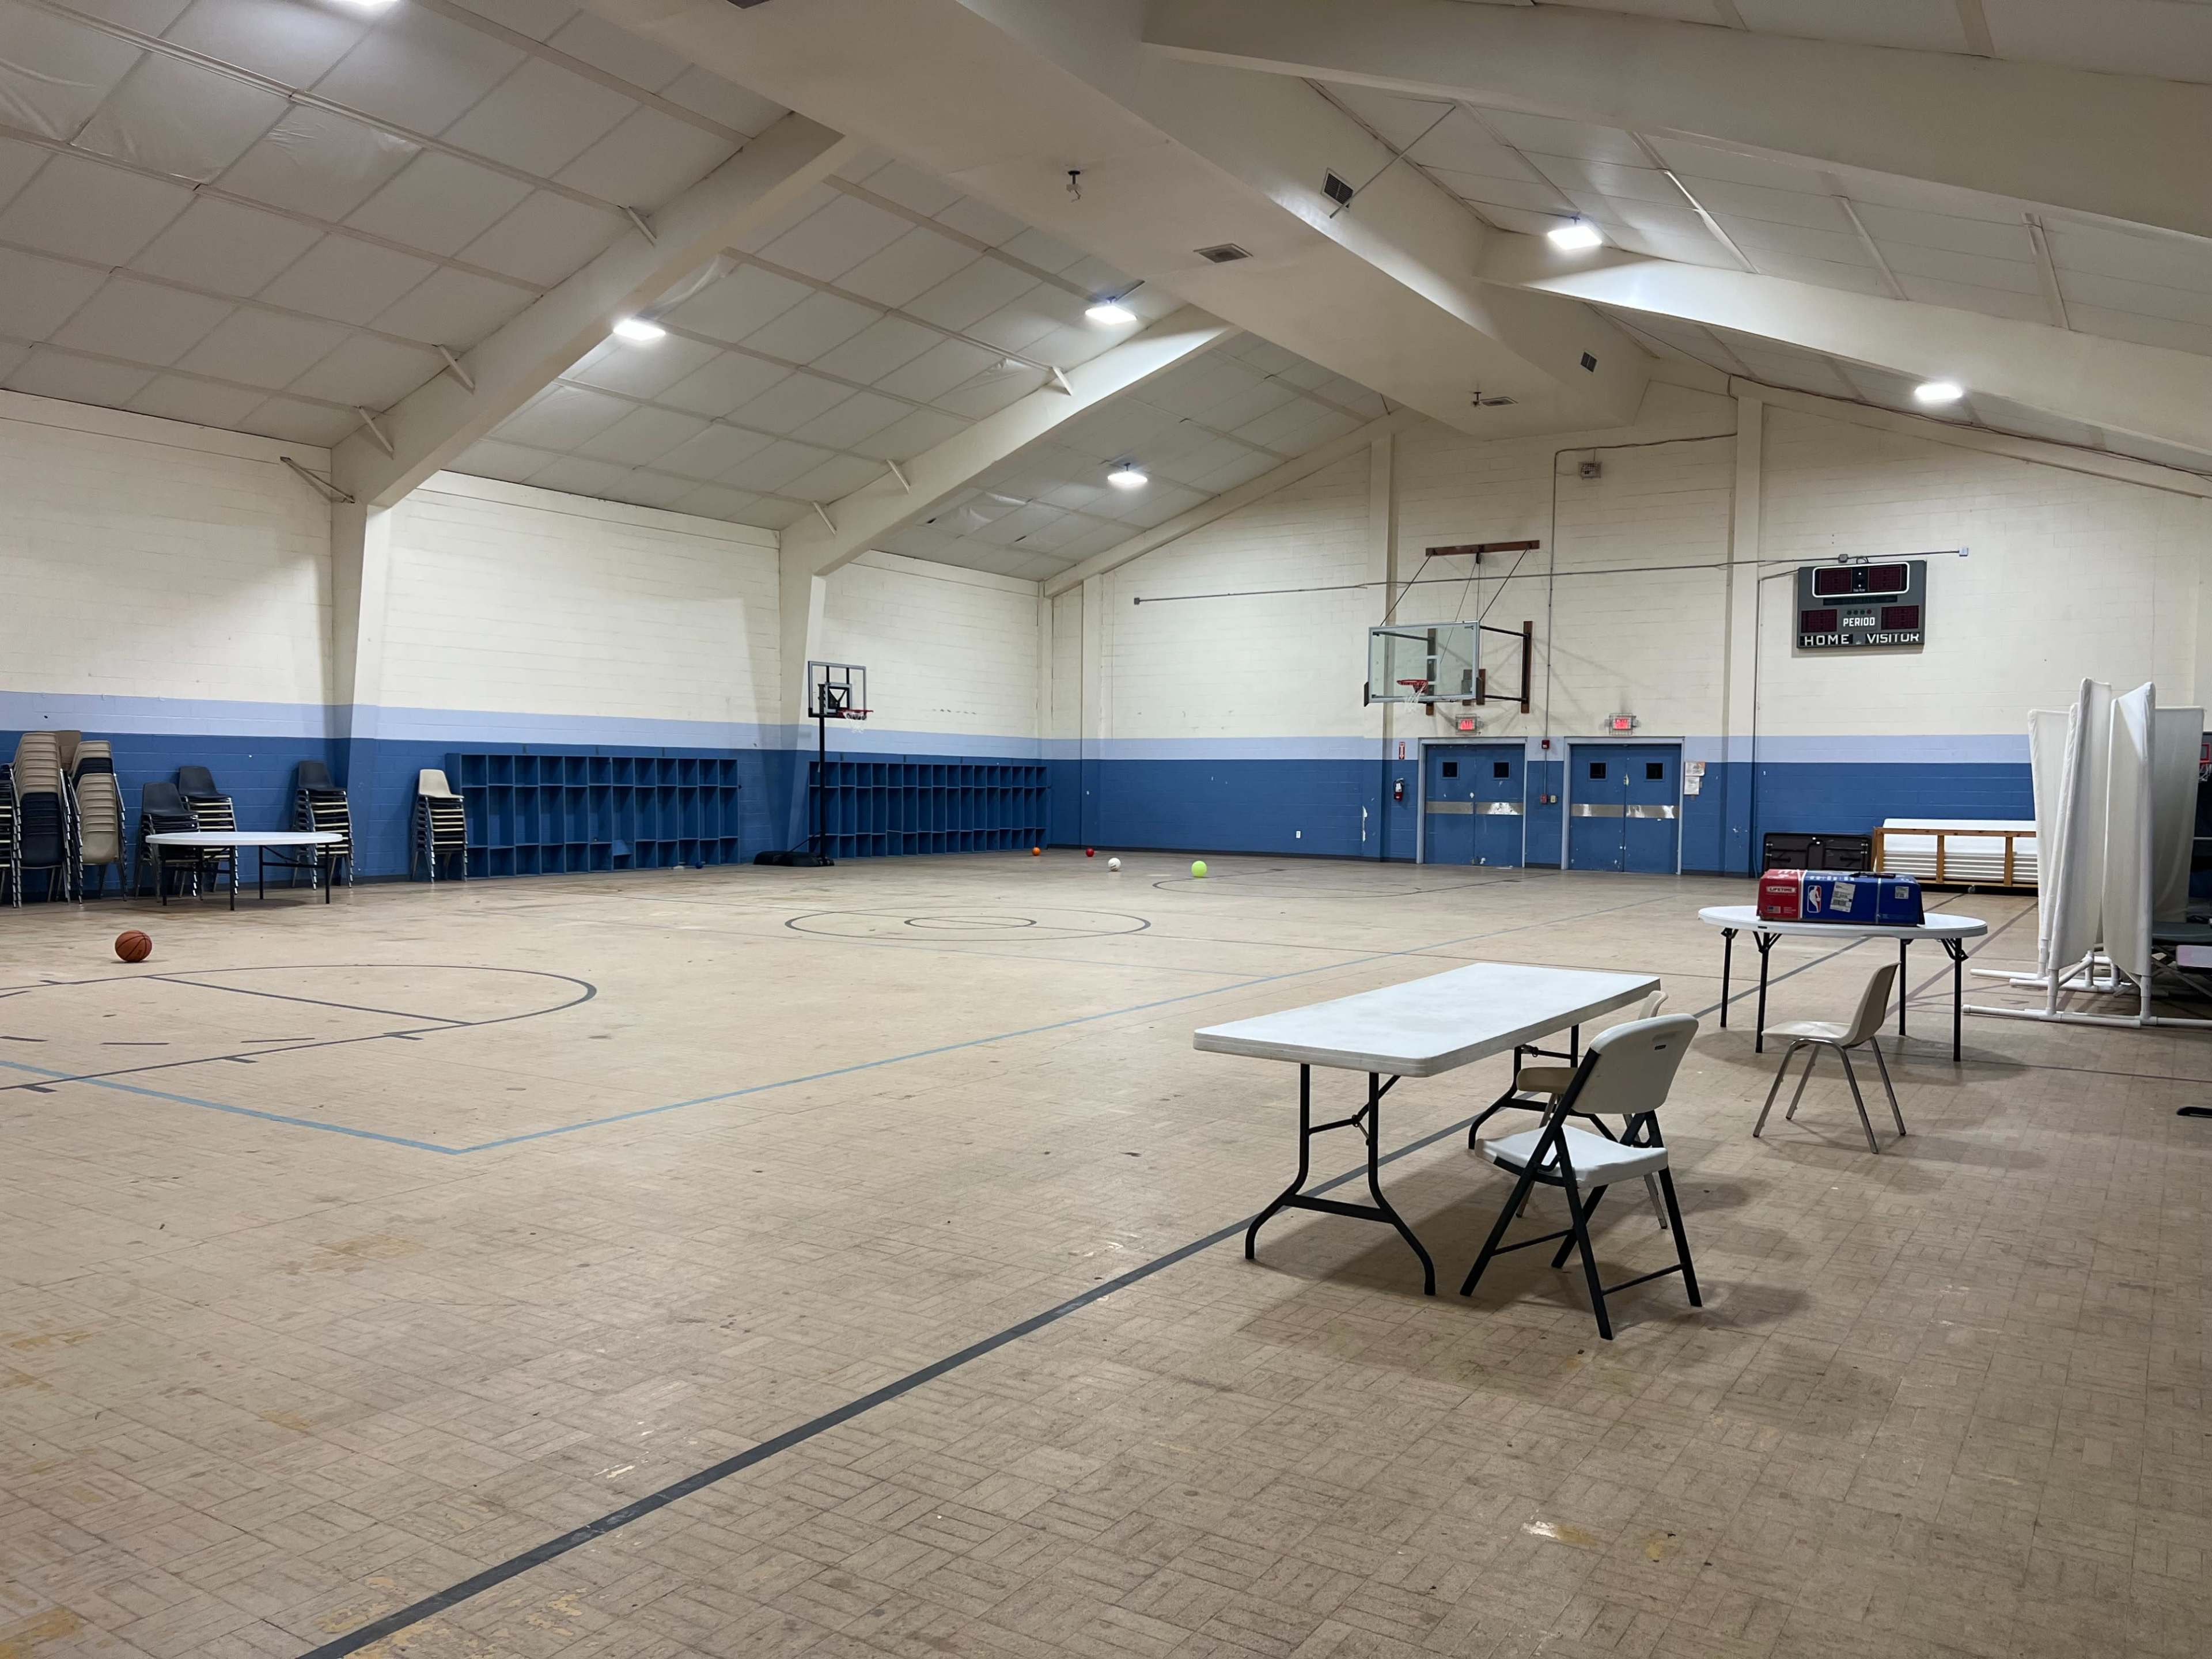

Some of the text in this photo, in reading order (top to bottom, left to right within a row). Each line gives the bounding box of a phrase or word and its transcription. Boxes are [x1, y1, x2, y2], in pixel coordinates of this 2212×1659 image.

[1843, 617, 1875, 627] PERIOD
[1805, 632, 1919, 646] HOME VISITOR
